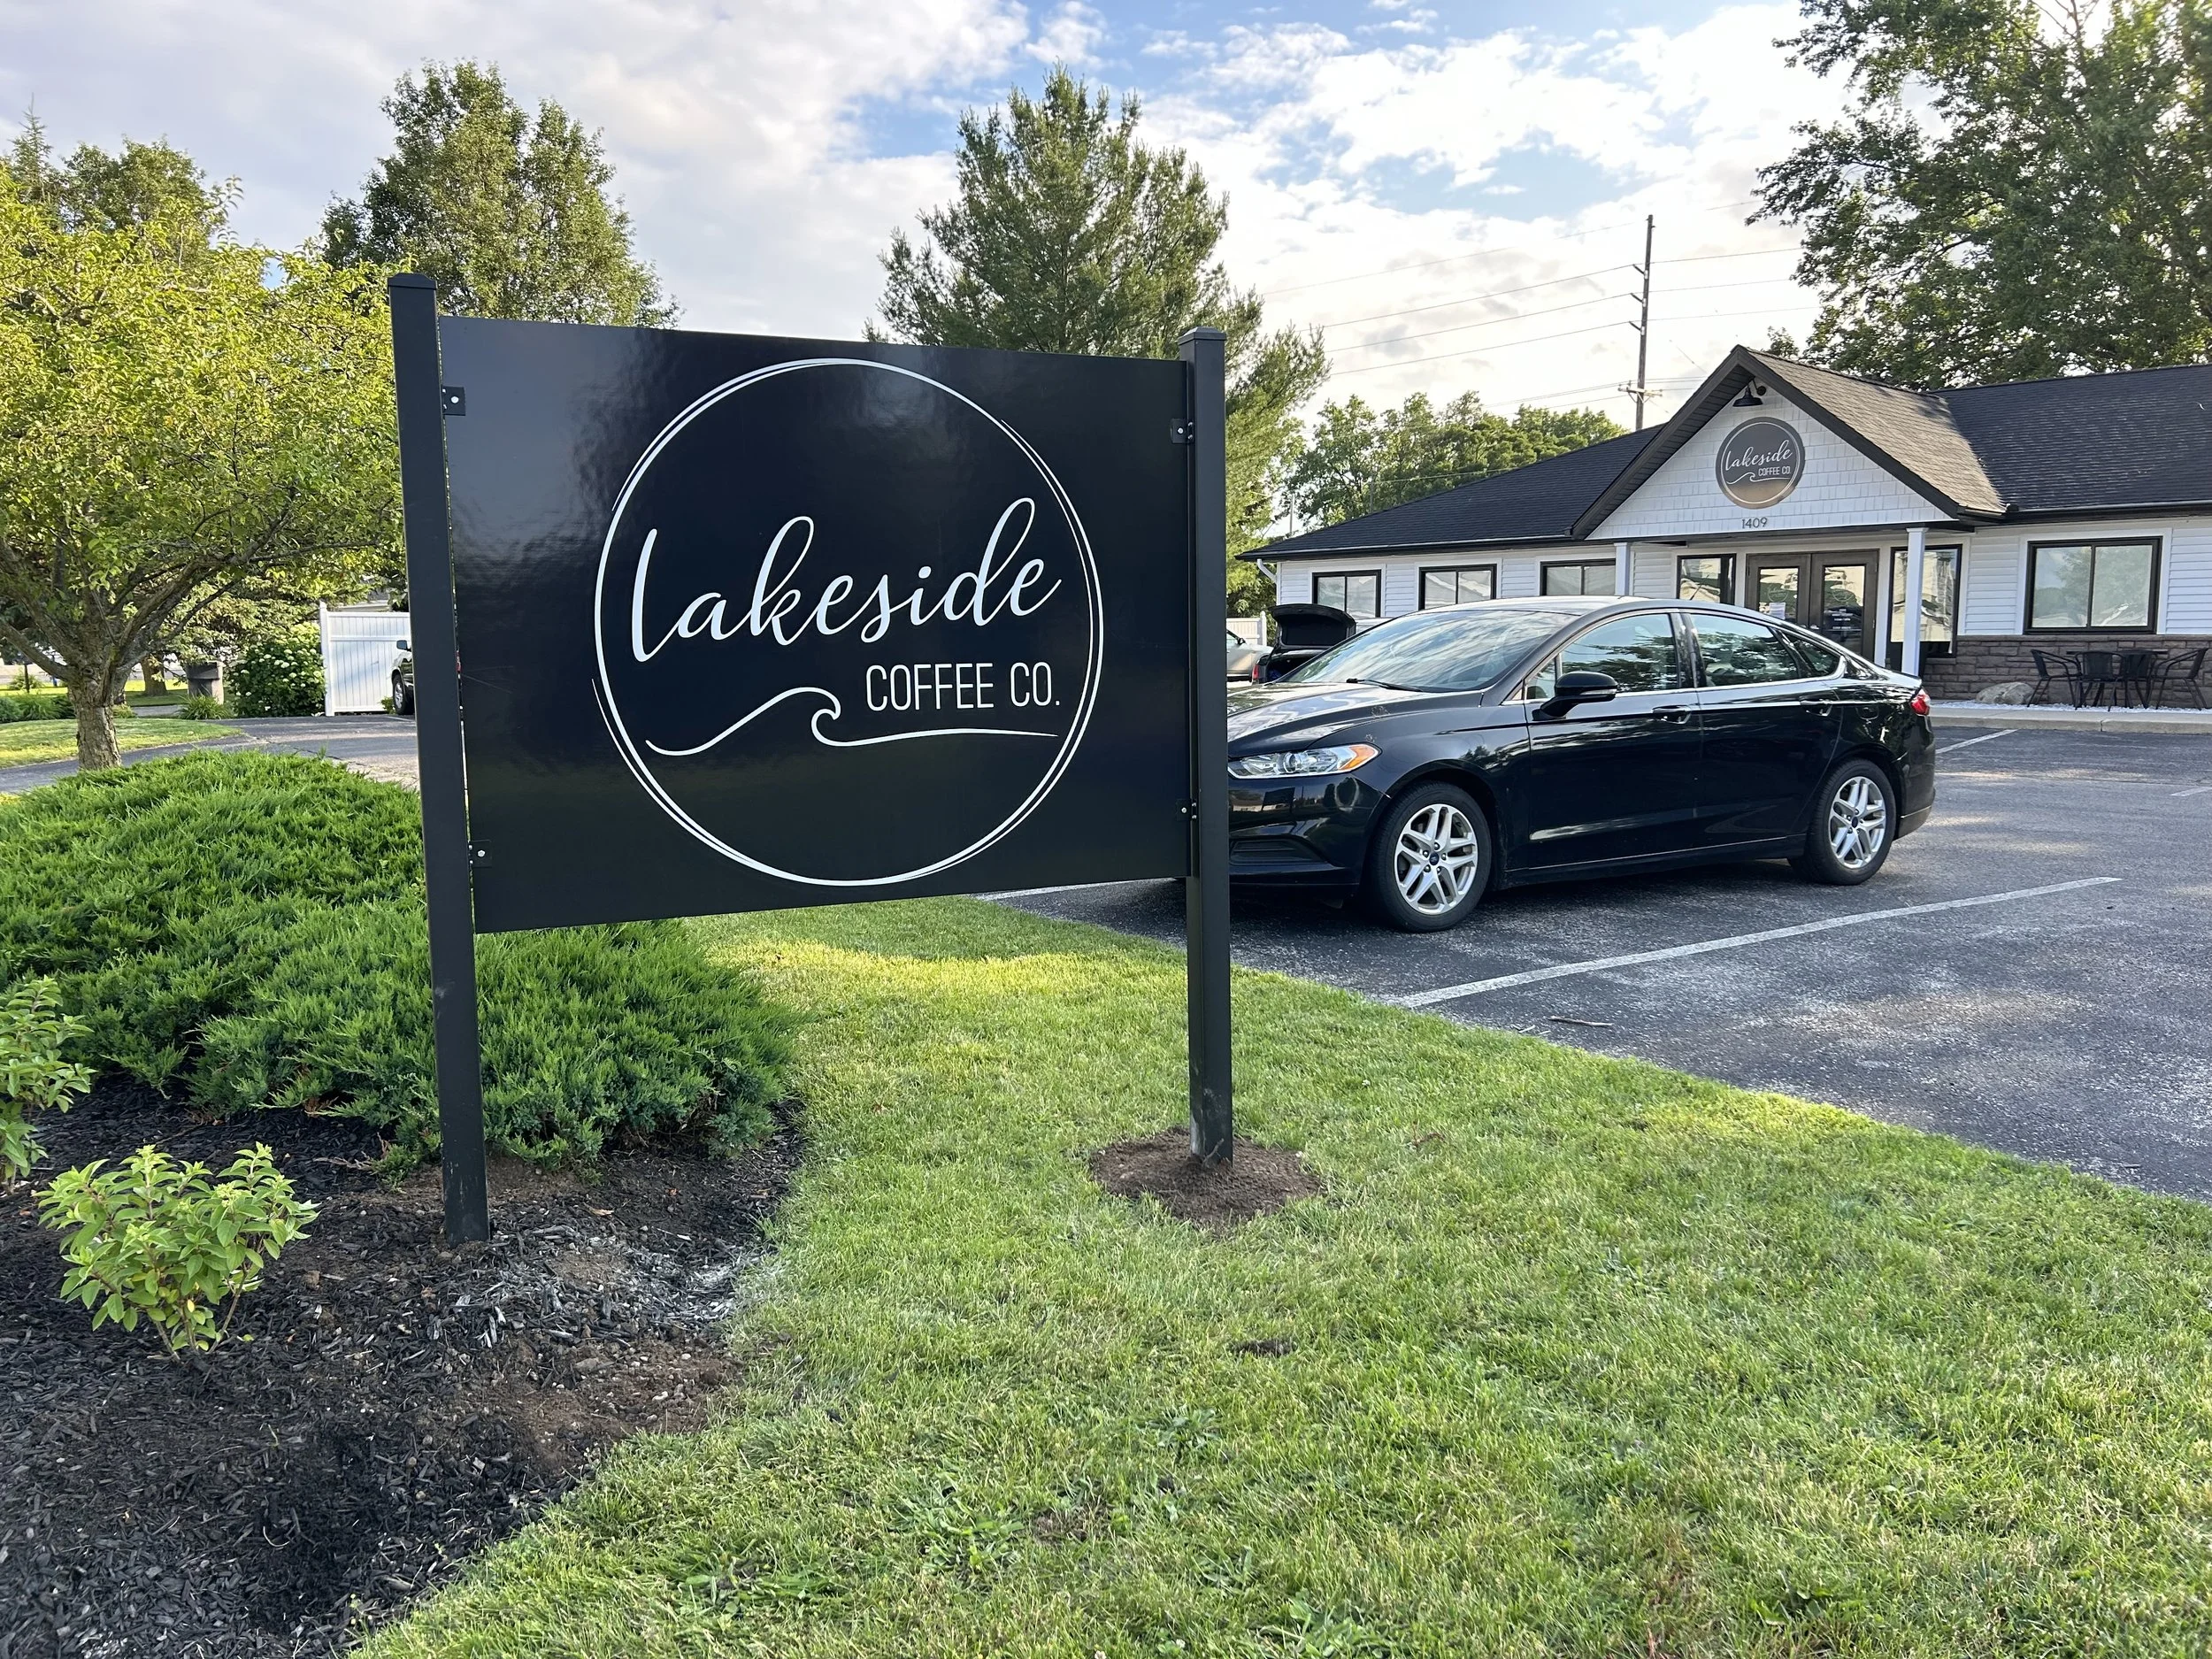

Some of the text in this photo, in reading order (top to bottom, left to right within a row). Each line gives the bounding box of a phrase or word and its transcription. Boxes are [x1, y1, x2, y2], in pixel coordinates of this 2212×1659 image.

[1758, 465, 1792, 477] COFFEE CO.
[1741, 517, 1768, 529] 1409
[866, 662, 1060, 711] COFFEE CO.
